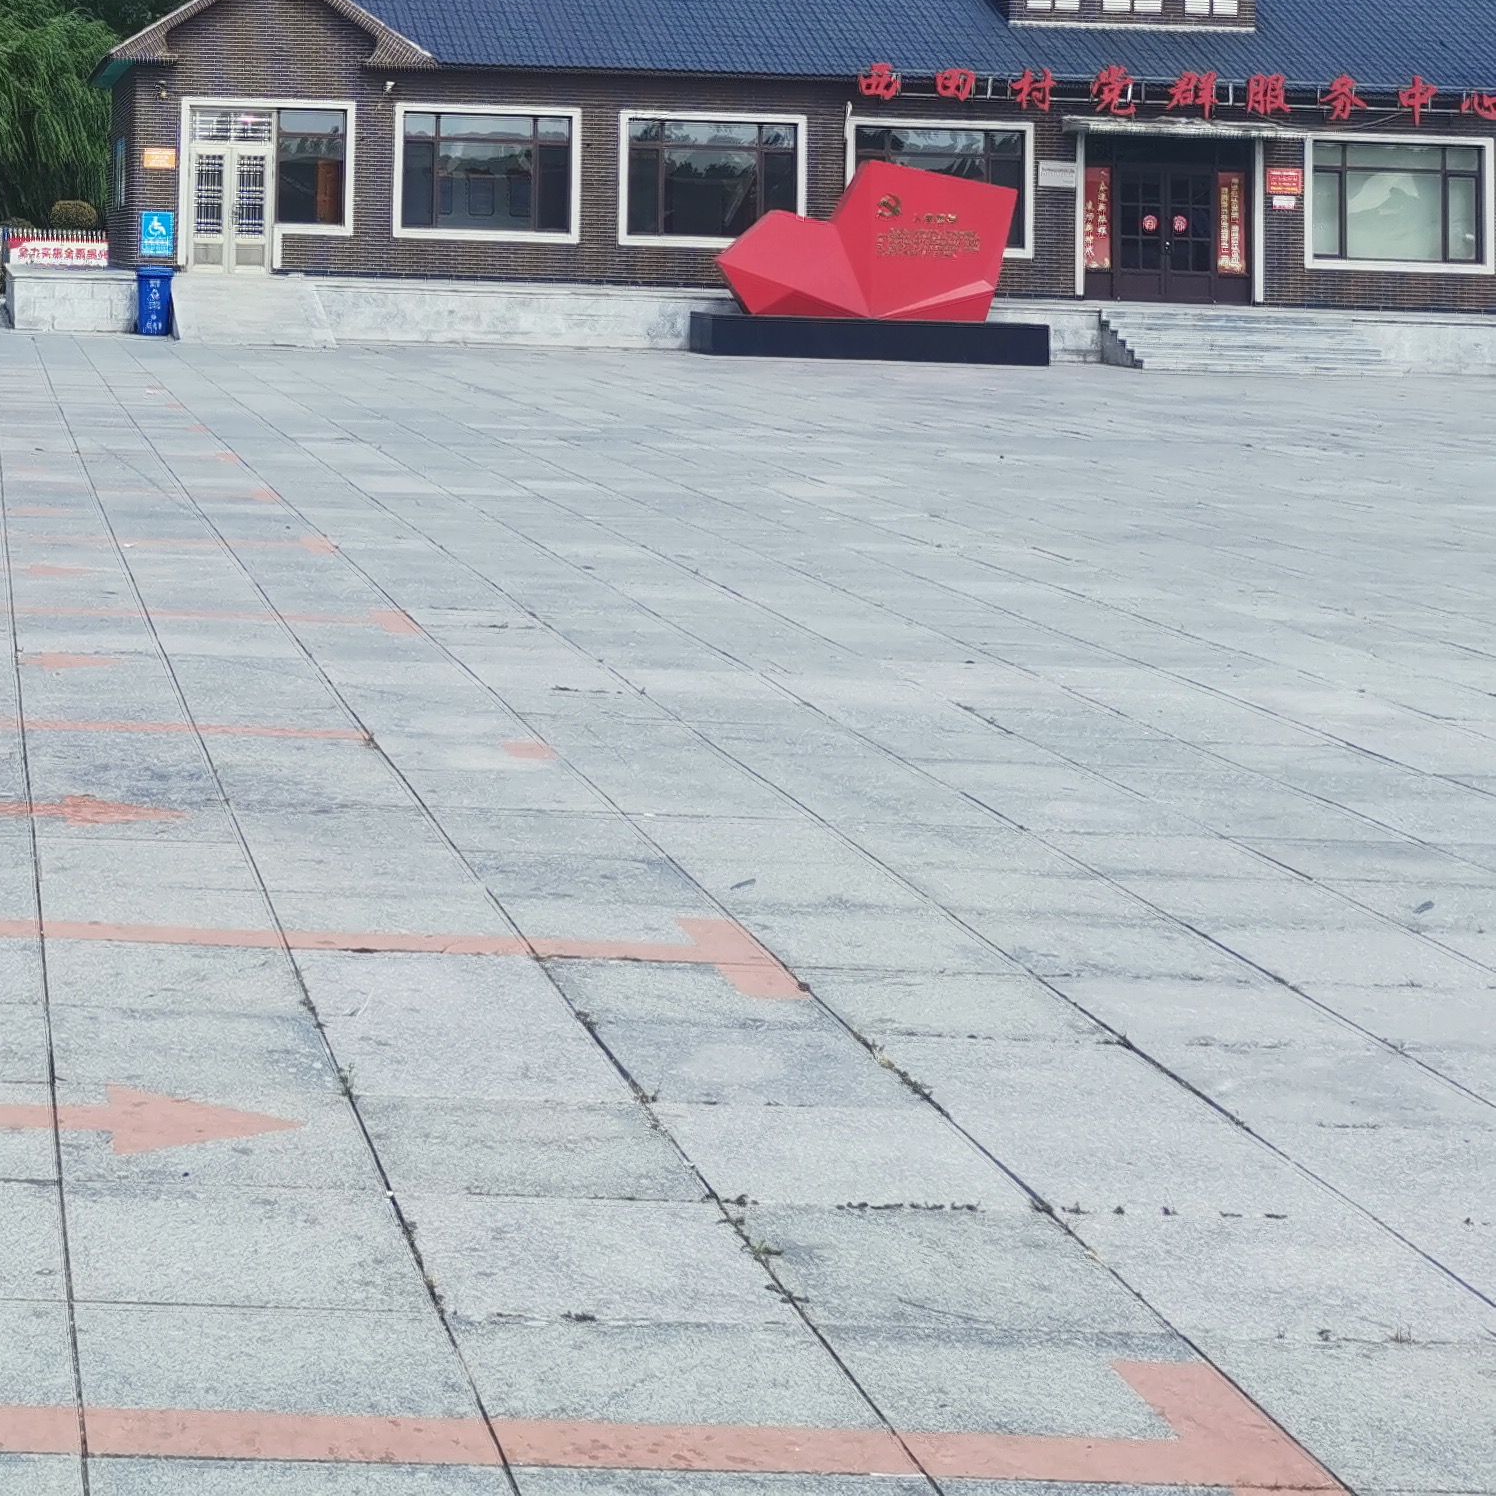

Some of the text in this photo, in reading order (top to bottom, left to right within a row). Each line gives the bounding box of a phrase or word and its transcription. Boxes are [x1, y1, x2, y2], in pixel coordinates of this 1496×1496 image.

[859, 62, 1496, 127] 西田村党群服务中心
